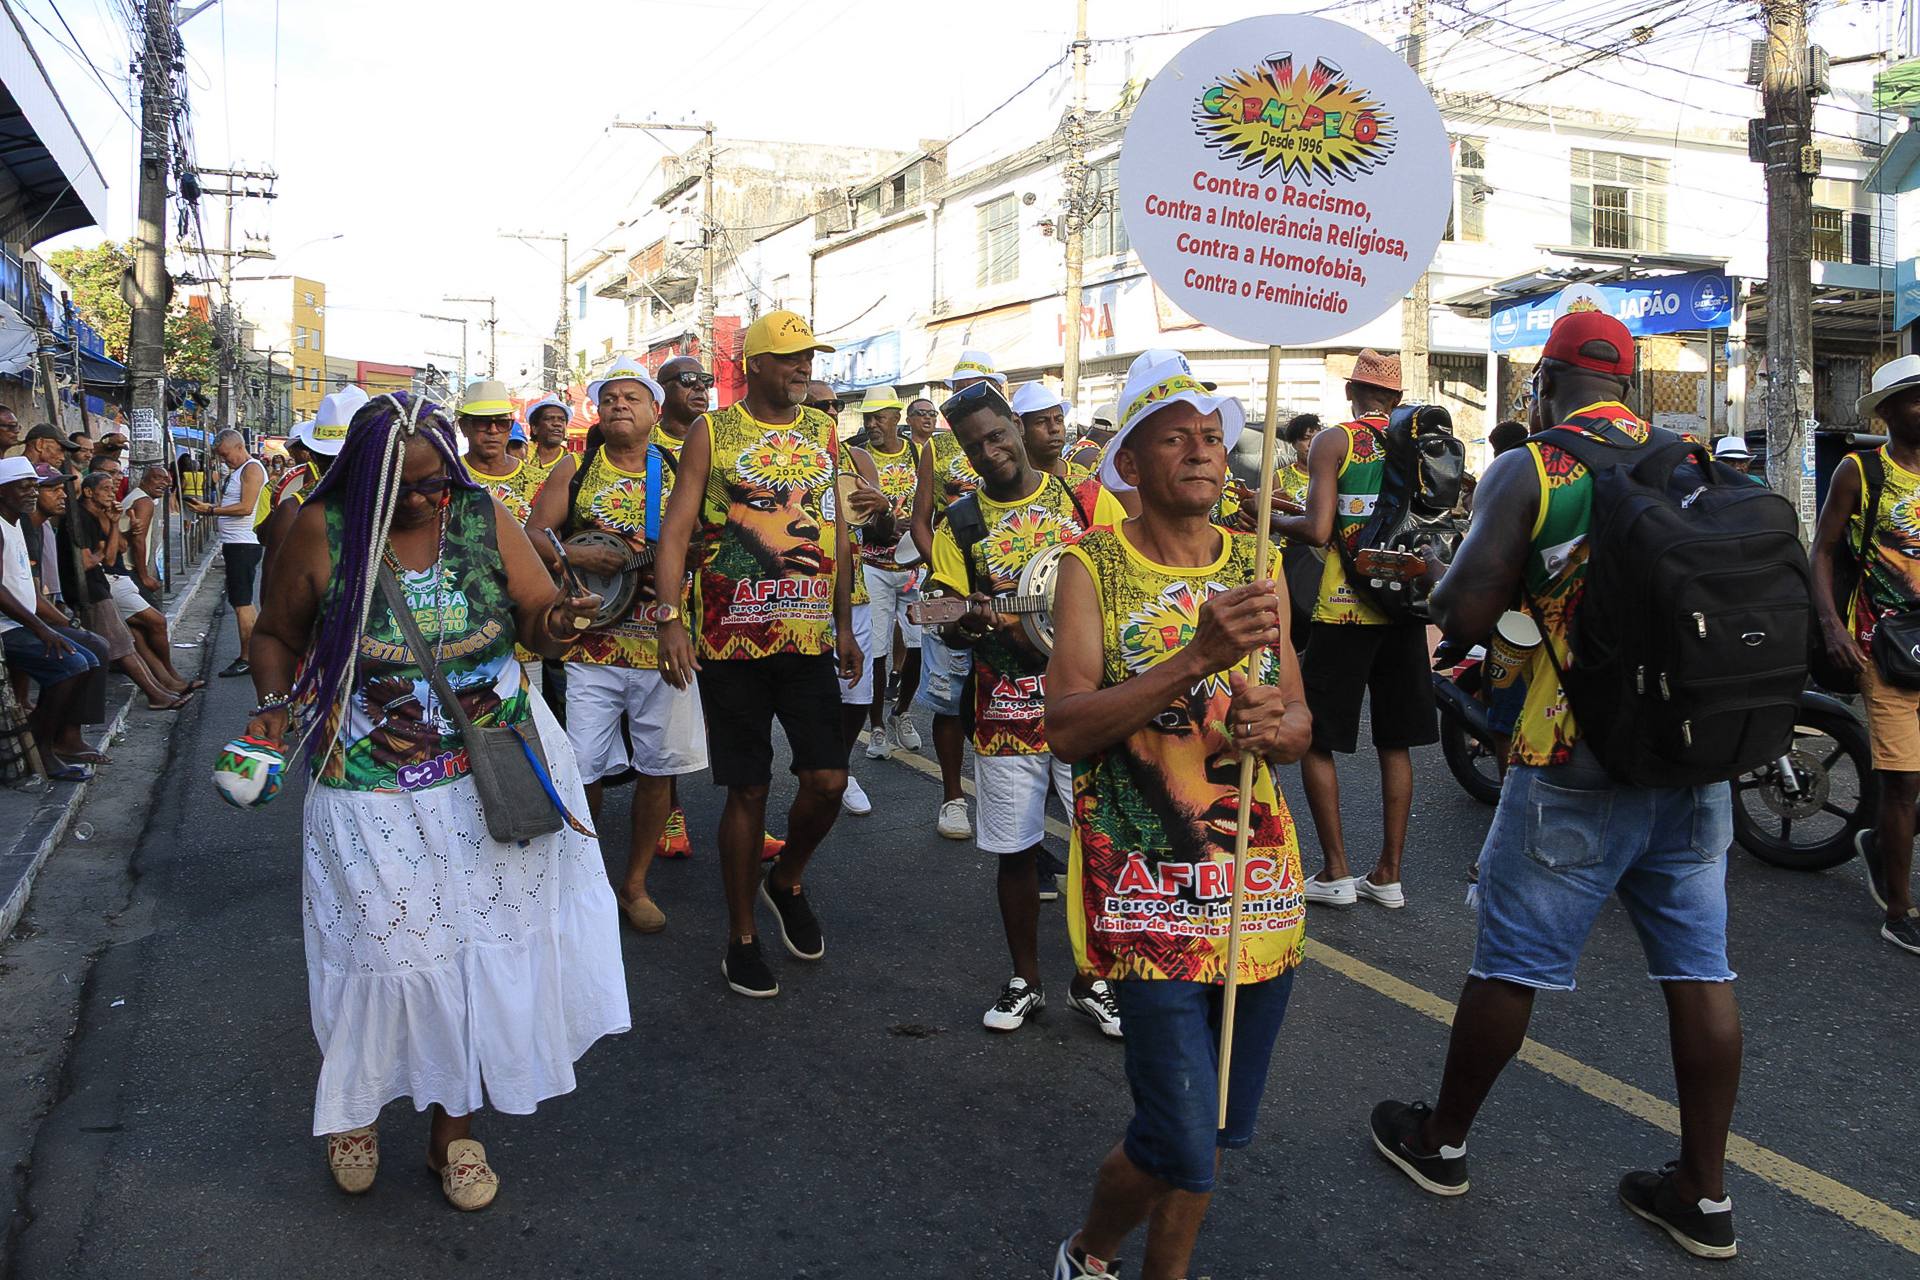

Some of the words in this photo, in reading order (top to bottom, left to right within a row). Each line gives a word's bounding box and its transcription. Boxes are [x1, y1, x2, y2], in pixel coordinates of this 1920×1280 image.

[1260, 131, 1295, 150] Desde
[1298, 136, 1323, 155] 1996
[1193, 171, 1260, 201] Contra
[1264, 186, 1278, 201] o
[1282, 185, 1371, 222] Racismo,
[1145, 195, 1202, 223] Contra
[1206, 209, 1217, 224] a
[1220, 206, 1322, 243] Intolerância
[1326, 224, 1408, 261] Religiosa,
[1176, 233, 1238, 262] Contra
[1243, 247, 1255, 263] a
[1259, 246, 1367, 287] Homofobia,
[1184, 269, 1238, 297] Contra
[1241, 283, 1252, 297] o
[1616, 290, 1680, 318] JAPÃO
[775, 468, 804, 476] 2026
[733, 578, 829, 603] ÁFRICA
[1106, 898, 1168, 915] Berço
[1172, 900, 1201, 917] da
[1146, 917, 1167, 931] de
[1169, 920, 1220, 935] pérola
